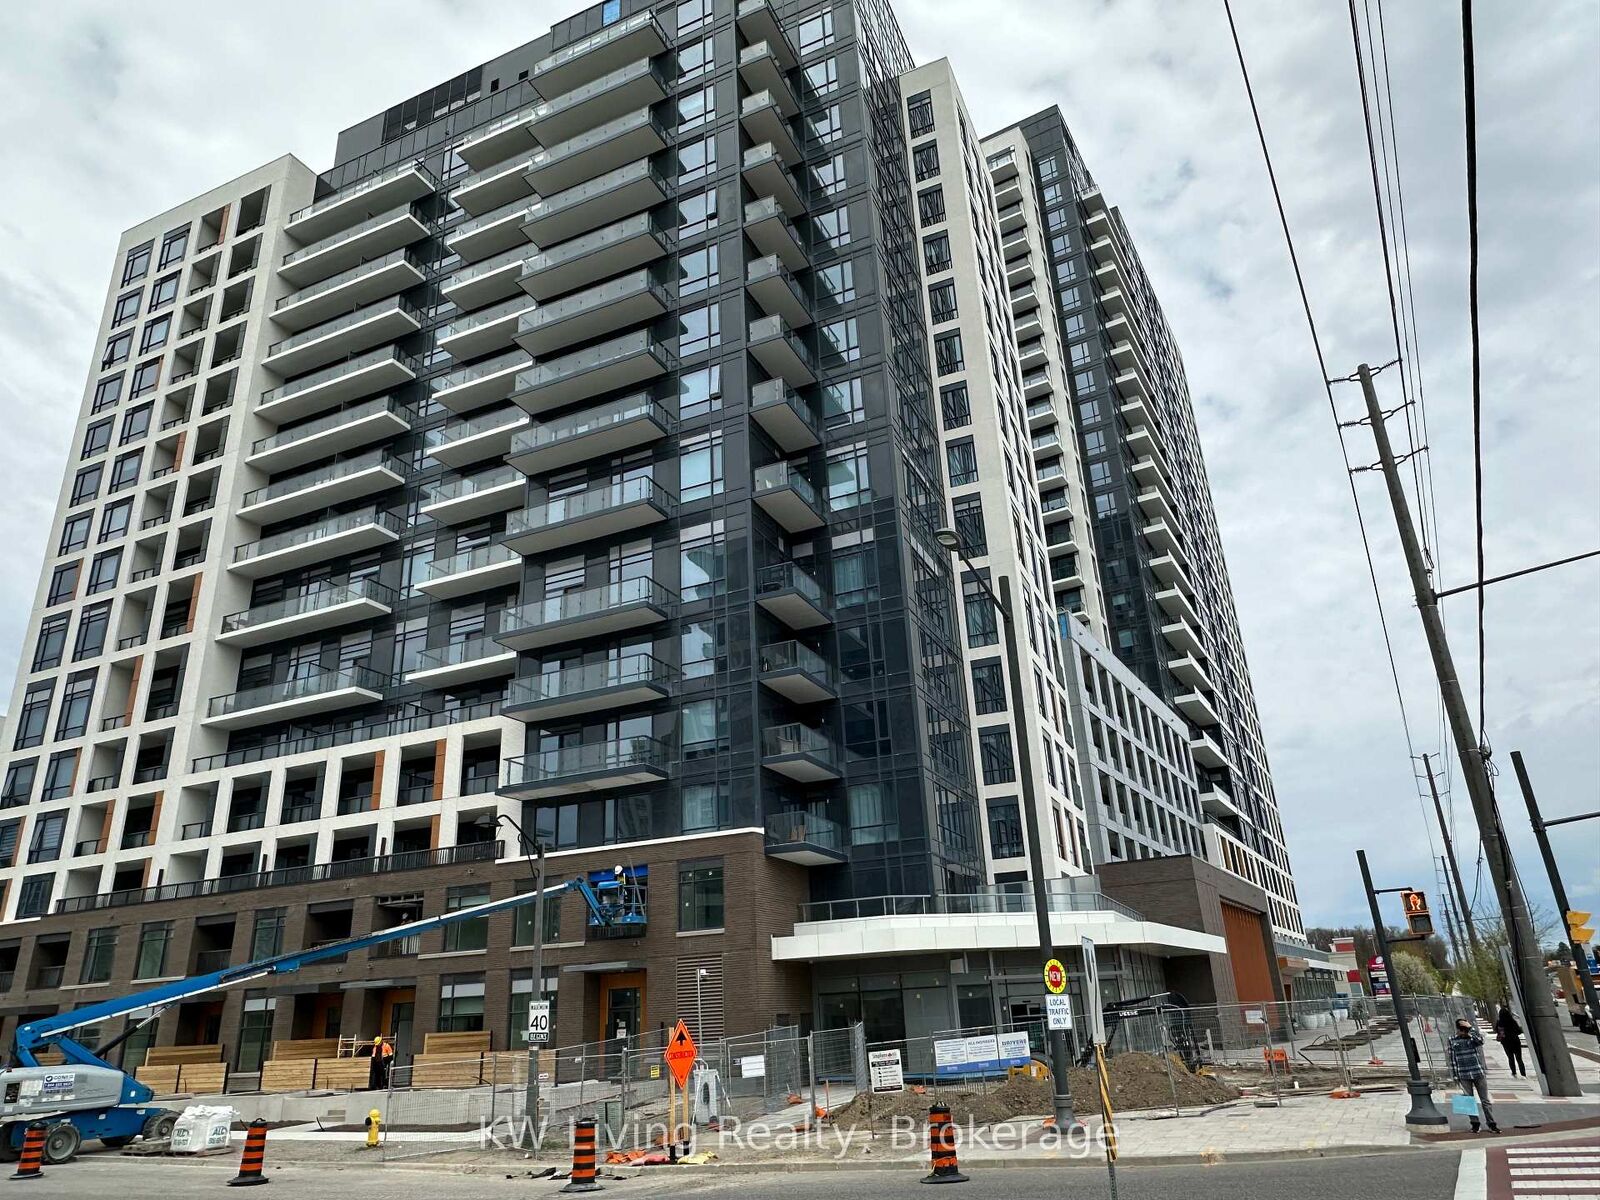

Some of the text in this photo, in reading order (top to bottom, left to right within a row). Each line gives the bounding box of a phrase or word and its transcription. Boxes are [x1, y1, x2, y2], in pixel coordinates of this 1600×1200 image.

[1049, 971, 1061, 982] NEW
[530, 1015, 548, 1031] 40
[1052, 1017, 1067, 1025] ONLY
